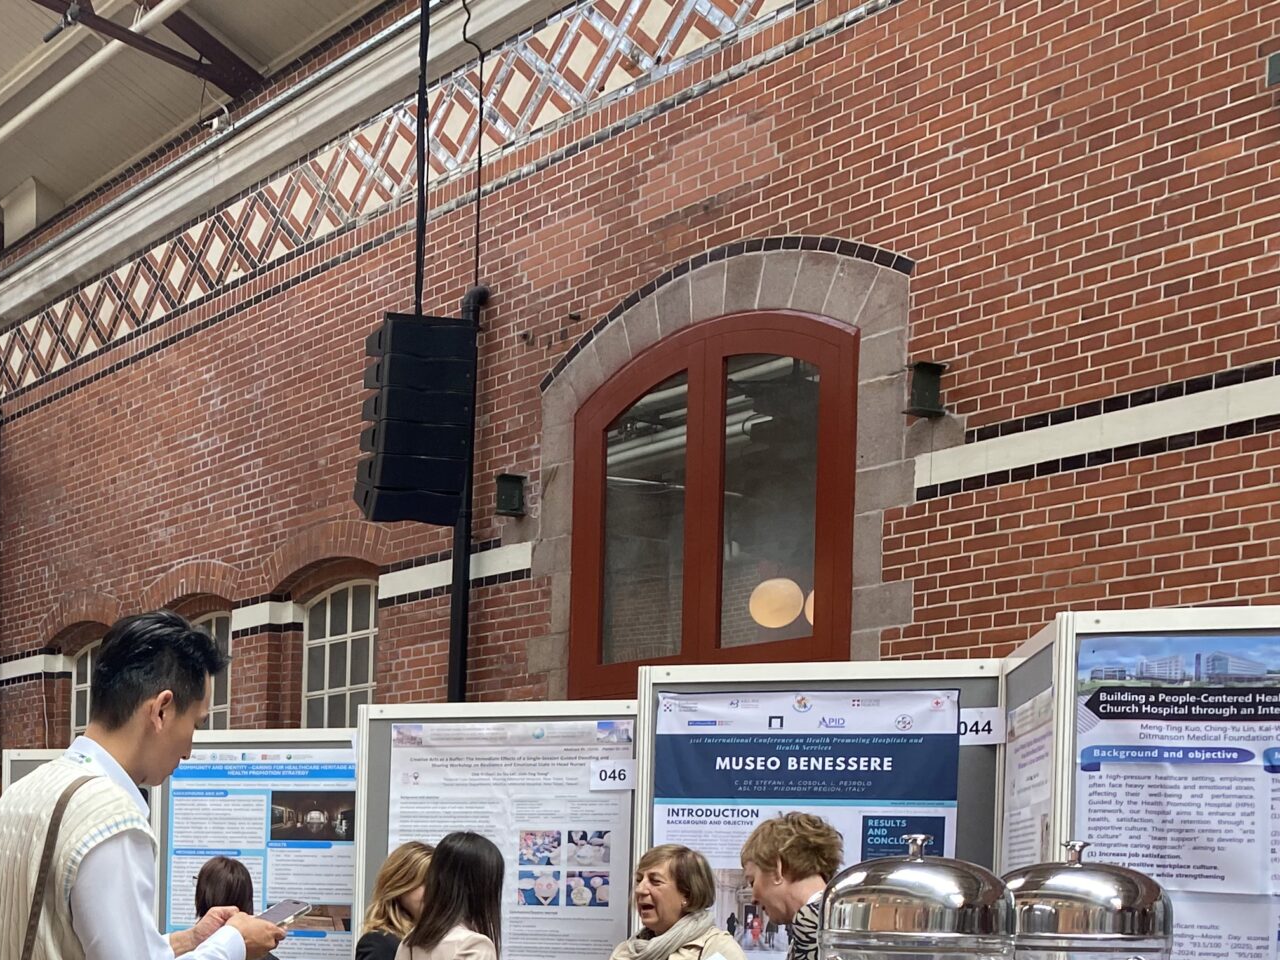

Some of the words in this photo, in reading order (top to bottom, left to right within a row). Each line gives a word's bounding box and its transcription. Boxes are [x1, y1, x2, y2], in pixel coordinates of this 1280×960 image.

[1099, 692, 1146, 704] Building
[1158, 693, 1253, 705] People-Centered
[1099, 703, 1139, 713] Church
[1142, 704, 1188, 716] Hospital
[1191, 705, 1237, 717] through
[1240, 707, 1254, 715] an
[960, 720, 993, 736] 044
[1204, 725, 1241, 734] Ching-Yu
[753, 736, 794, 744] Conference
[1139, 732, 1185, 741] Ditmanson
[1187, 733, 1221, 741] Medical
[1223, 733, 1274, 742] Foundation
[1093, 749, 1158, 759] Background
[1163, 749, 1183, 758] and
[1188, 750, 1239, 760] objective
[715, 756, 781, 770] MUSEO
[787, 756, 893, 771] BENESSERE
[599, 768, 627, 782] 046
[1106, 774, 1151, 782] high-pressure
[1088, 790, 1117, 798] affecting
[667, 808, 759, 818] INTRODUCTION
[867, 819, 907, 827] RESULTS
[1156, 862, 1191, 870] workplace
[1175, 872, 1225, 881] strengthening
